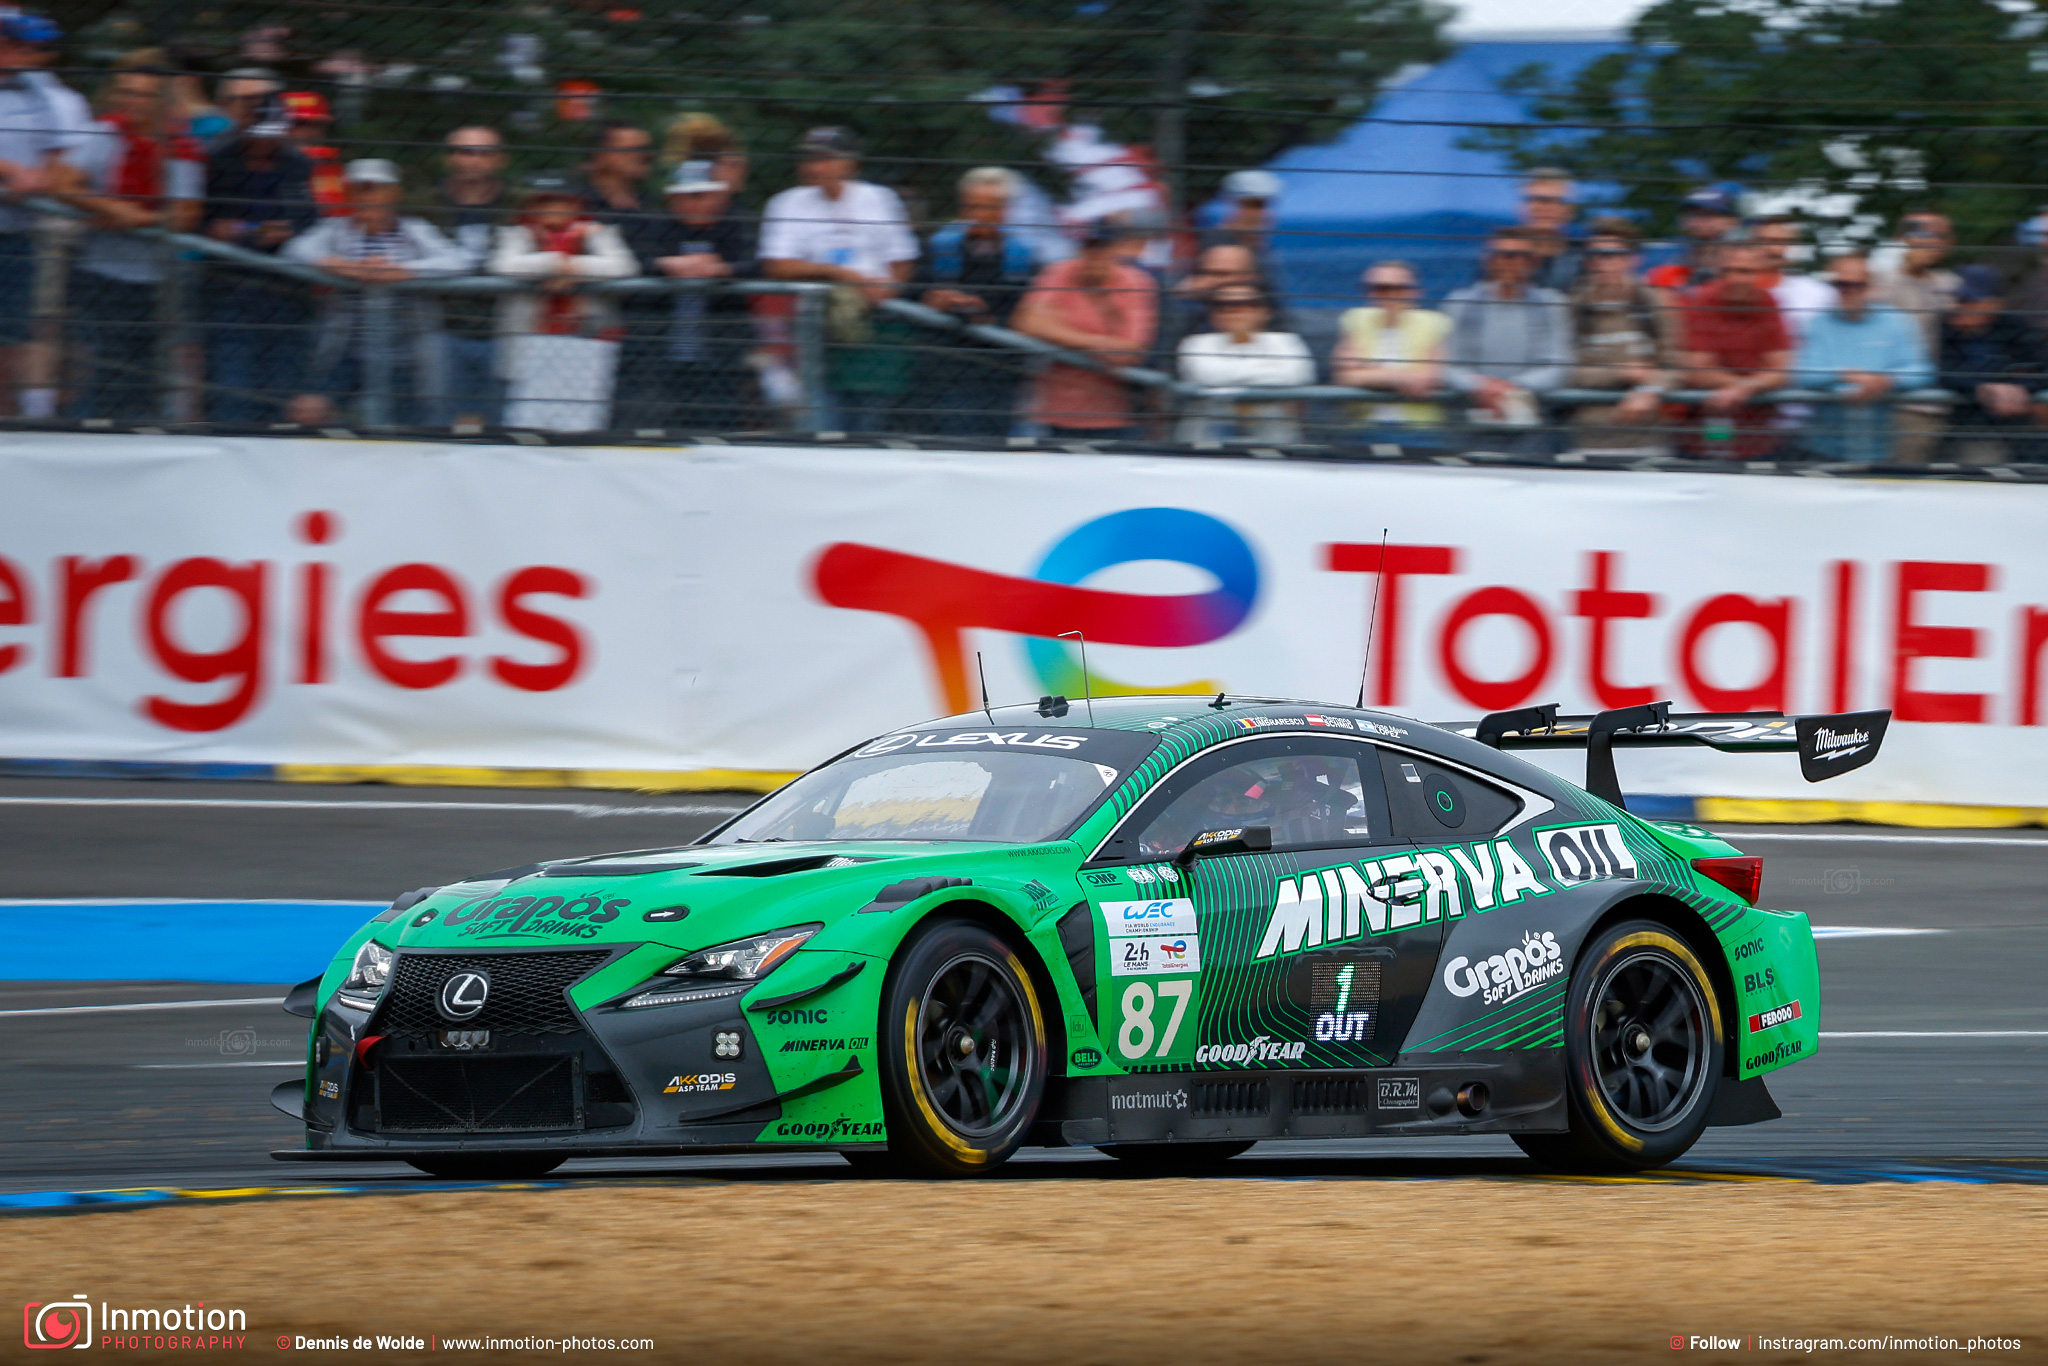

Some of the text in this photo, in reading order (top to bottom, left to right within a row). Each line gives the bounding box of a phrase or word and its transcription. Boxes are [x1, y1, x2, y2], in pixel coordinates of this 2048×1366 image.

[915, 731, 1089, 750] LEXUS
[1813, 726, 1869, 752] Milwaukee
[1086, 873, 1117, 885] OMP
[1256, 827, 1637, 958] MINERVA OIL
[1123, 901, 1173, 920] WEC
[457, 918, 603, 939] SOFT DRINKS
[1336, 961, 1355, 1011] 1
[1483, 957, 1564, 1005] SOFT DRINKS
[1744, 967, 1775, 993] BLS
[1118, 979, 1193, 1060] 87
[1315, 1011, 1369, 1041] OUT
[1760, 1005, 1793, 1028] FERODO
[778, 1036, 869, 1053] MINERVA OIL
[1074, 1051, 1099, 1063] BELL
[678, 1082, 719, 1093] ASP TEAM
[1111, 1090, 1173, 1109] matmut
